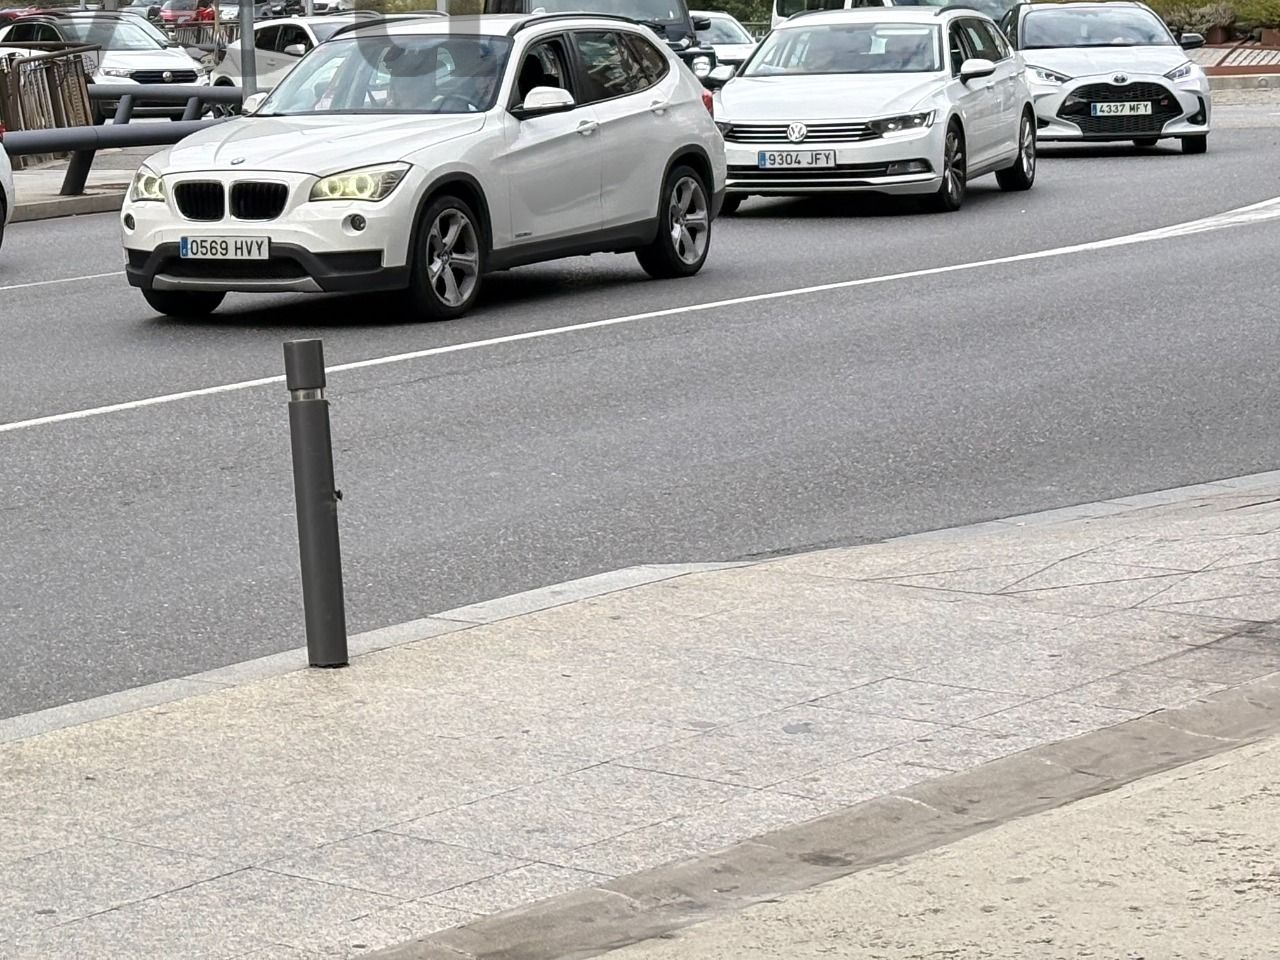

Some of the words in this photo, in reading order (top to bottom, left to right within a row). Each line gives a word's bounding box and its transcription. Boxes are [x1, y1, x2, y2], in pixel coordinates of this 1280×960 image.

[1099, 104, 1126, 113] 4337
[1129, 103, 1149, 113] MFY
[768, 153, 802, 165] 9304
[806, 152, 832, 165] JFY
[190, 240, 228, 257] 0569
[234, 240, 264, 257] HVY
